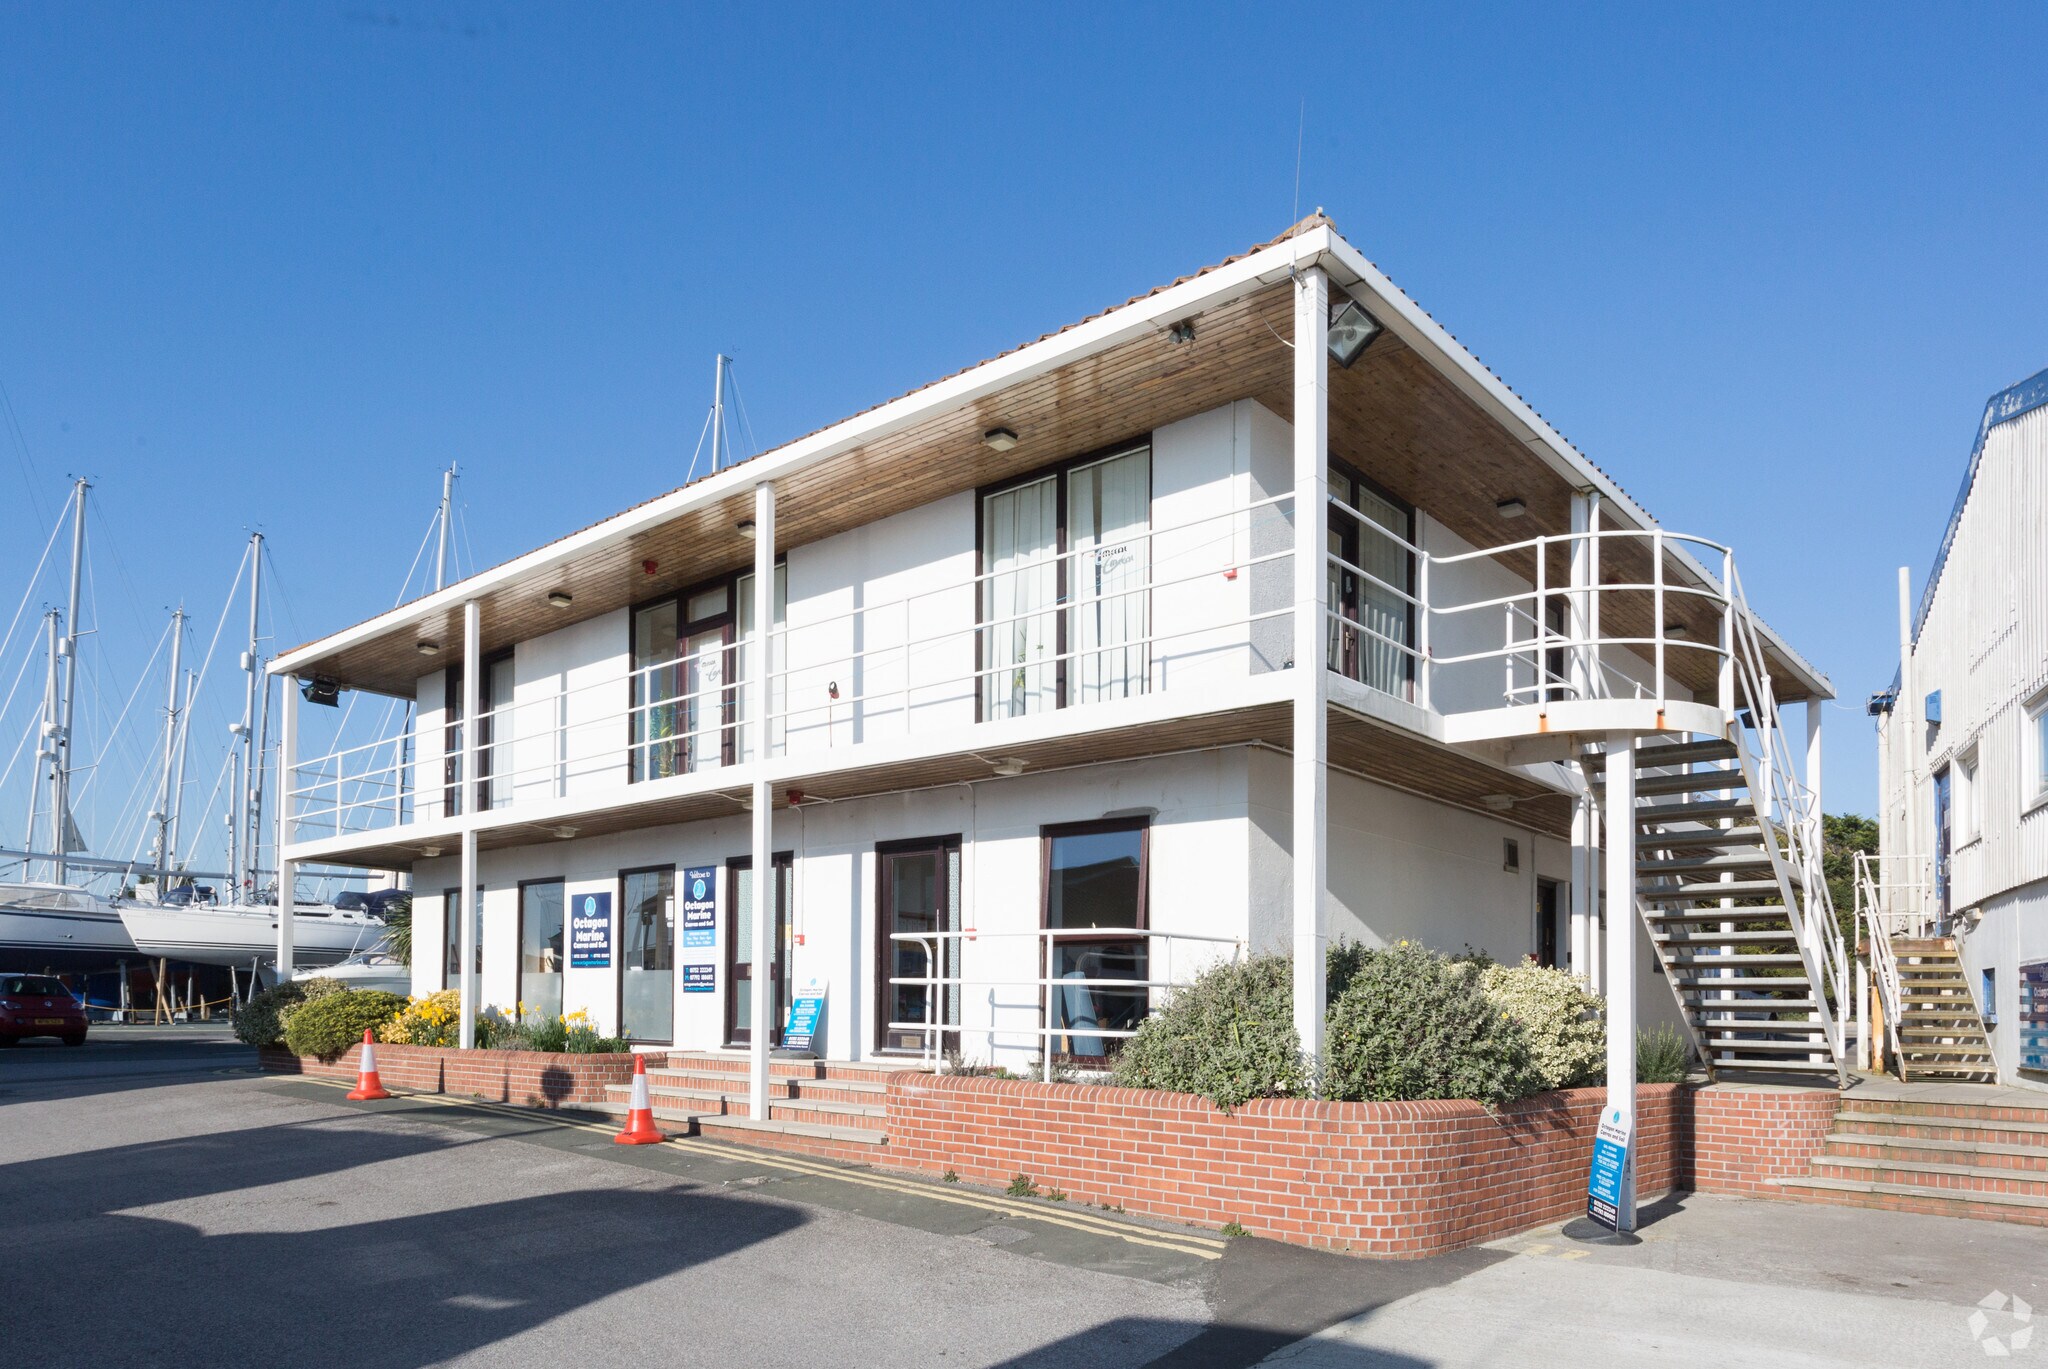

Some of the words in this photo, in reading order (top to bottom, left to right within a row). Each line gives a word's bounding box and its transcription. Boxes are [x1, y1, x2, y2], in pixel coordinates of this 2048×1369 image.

[685, 901, 714, 911] Octagon
[687, 910, 711, 920] Marine
[573, 917, 608, 930] Octagon
[576, 930, 605, 942] Marine
[1602, 1123, 1614, 1131] Octagon
[1600, 1129, 1611, 1138] Canvas
